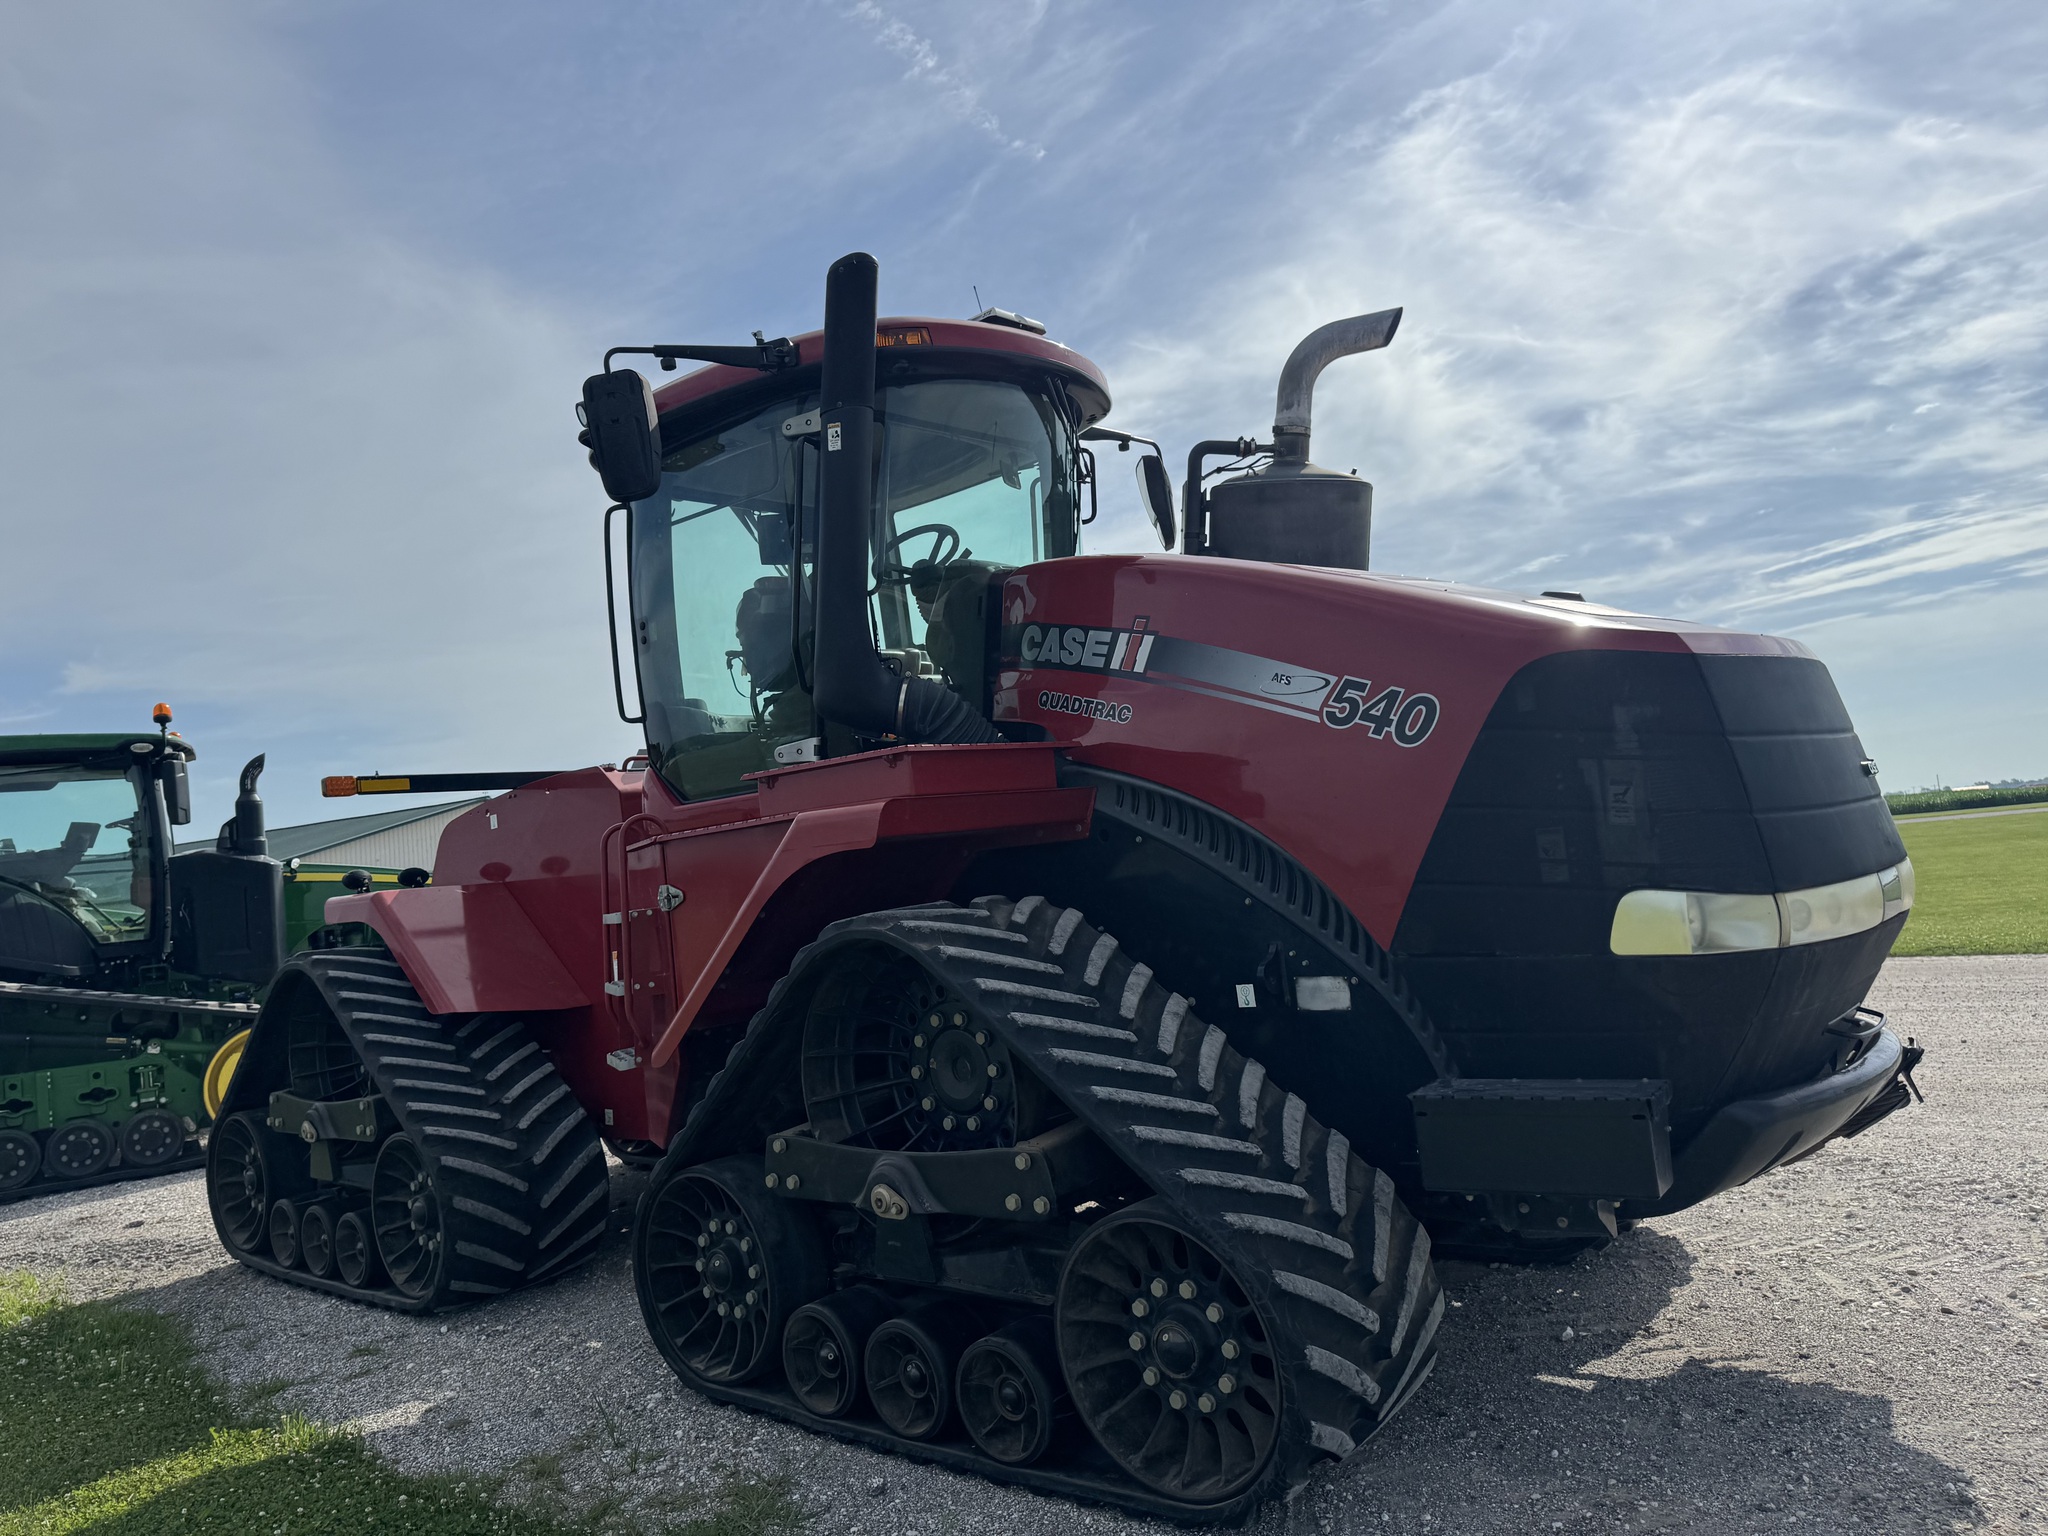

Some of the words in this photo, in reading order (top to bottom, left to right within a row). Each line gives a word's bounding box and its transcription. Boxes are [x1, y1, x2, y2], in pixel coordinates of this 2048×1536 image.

[1021, 624, 1113, 668] CASE
[1271, 672, 1292, 686] AFS
[1038, 690, 1133, 724] QUADTRAC
[1322, 675, 1441, 748] 540
